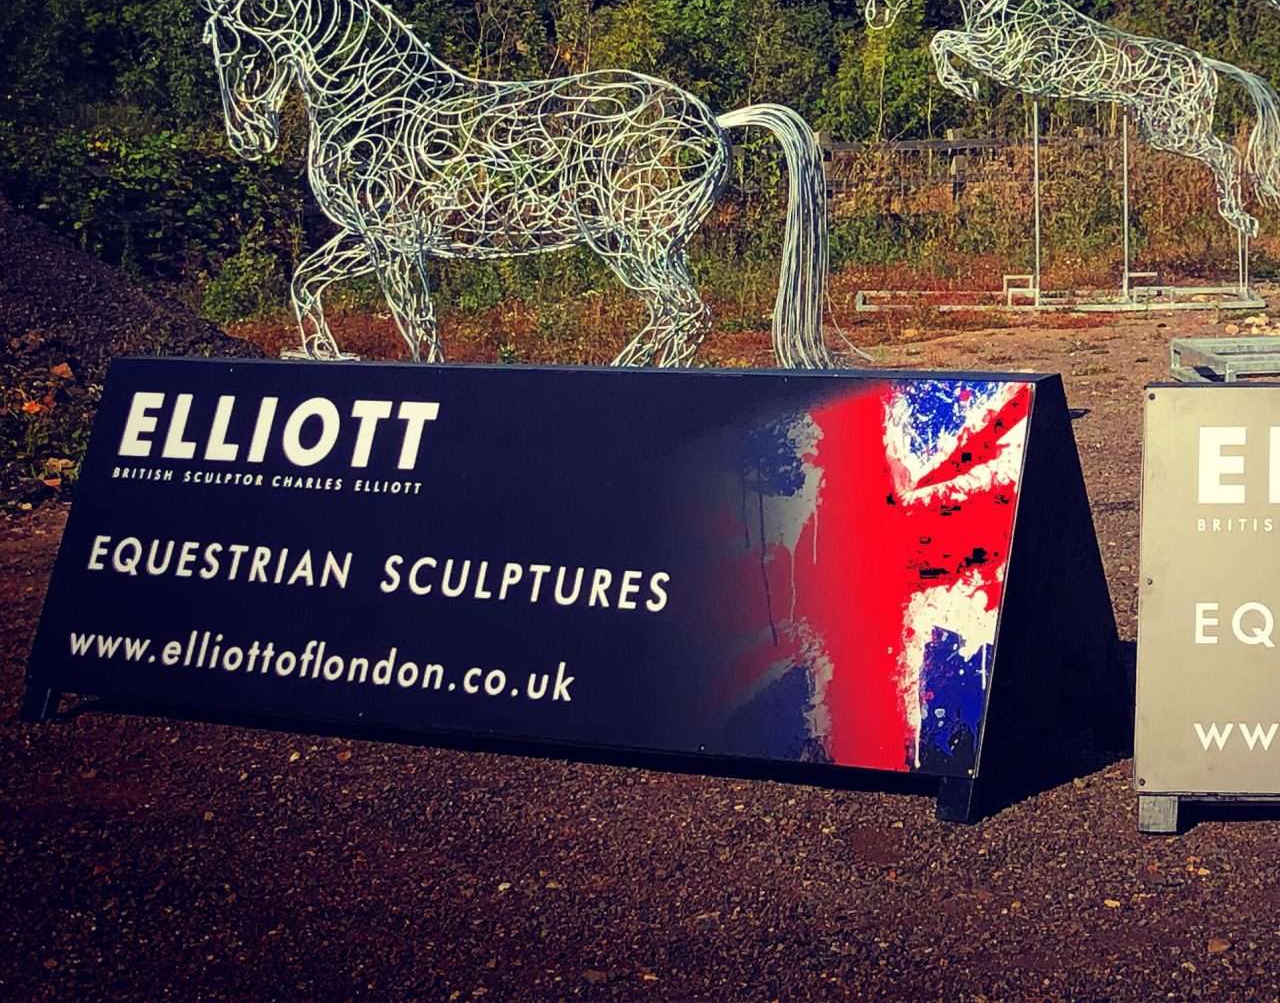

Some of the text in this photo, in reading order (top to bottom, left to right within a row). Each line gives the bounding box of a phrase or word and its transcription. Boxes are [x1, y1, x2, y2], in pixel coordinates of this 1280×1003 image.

[116, 391, 441, 471] ELLIOTT
[111, 466, 423, 495] BRITISH SCULPTOR CHARLES ELLIOTT
[87, 535, 671, 612] EQUESTRIAN SCULPTURES
[69, 630, 576, 702] www.elliottoflondon.co.uk
